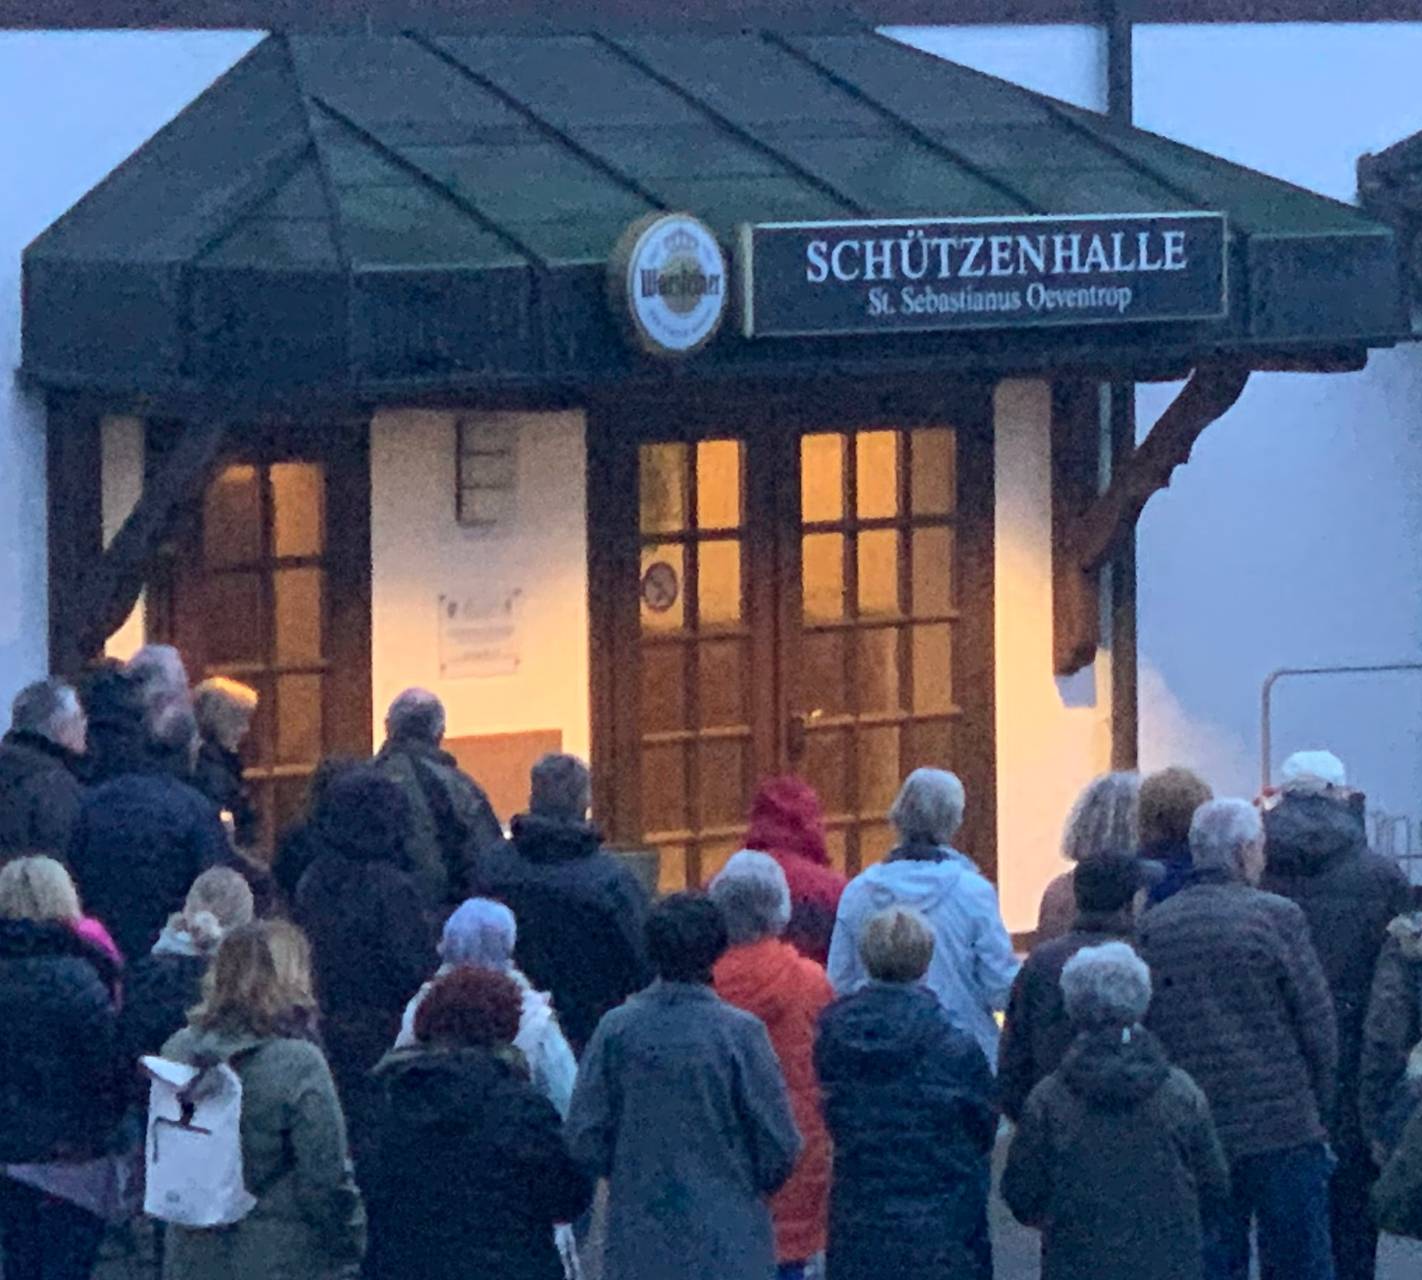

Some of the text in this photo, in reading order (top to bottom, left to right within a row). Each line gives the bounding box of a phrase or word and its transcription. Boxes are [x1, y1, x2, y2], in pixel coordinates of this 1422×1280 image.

[806, 230, 1188, 282] SCHÜTZENHALLE
[868, 282, 1133, 315] St. Sebastianus Oeventrop
